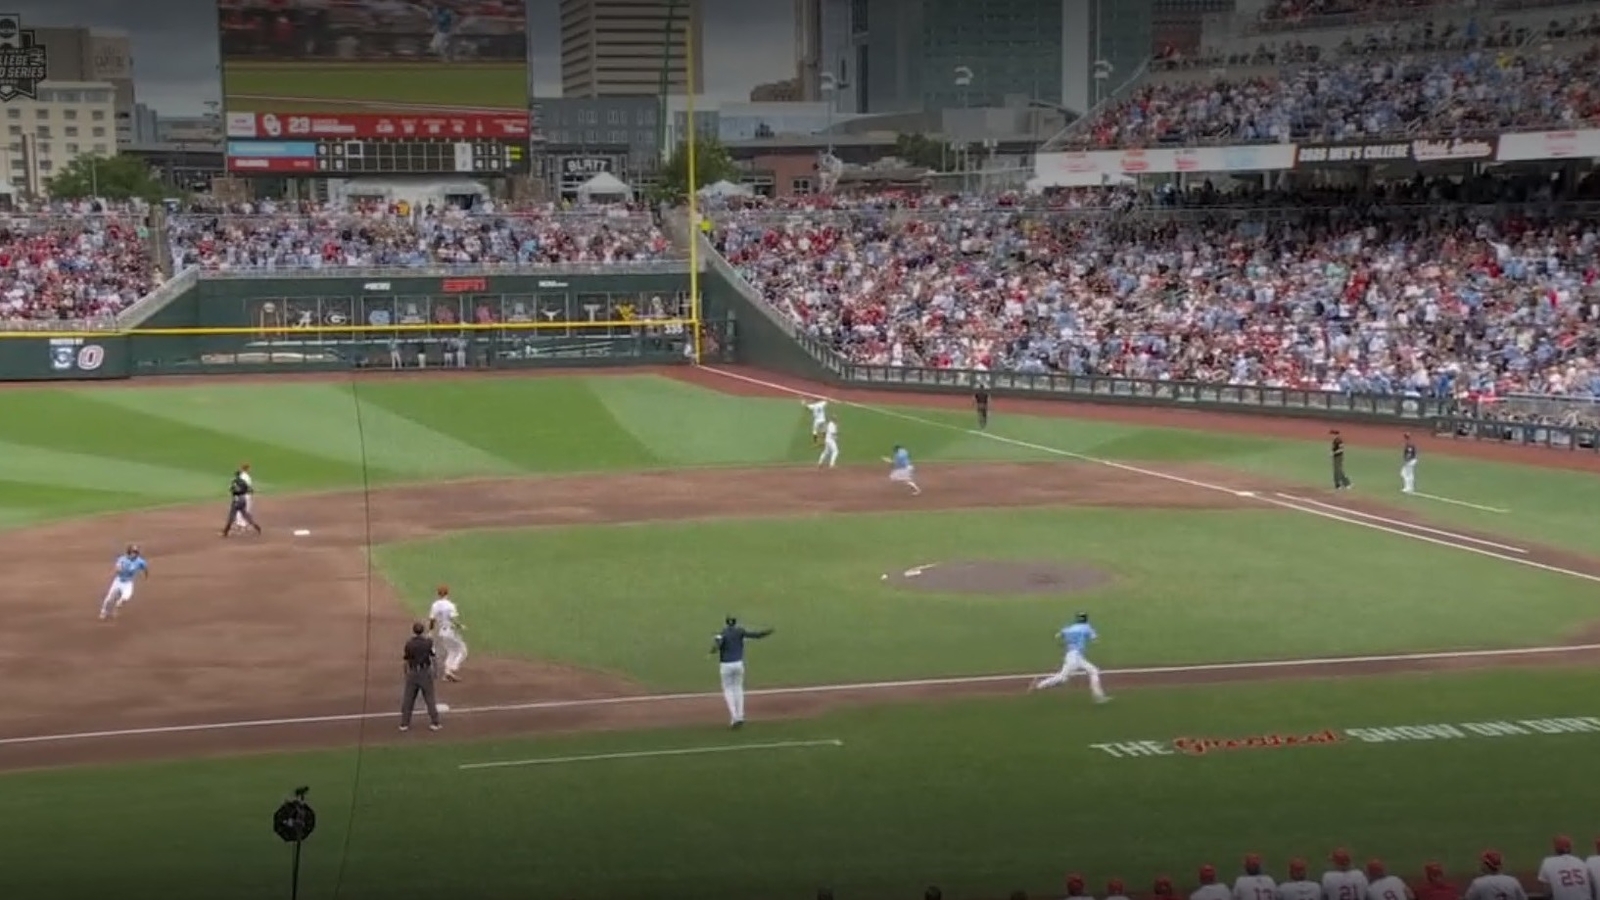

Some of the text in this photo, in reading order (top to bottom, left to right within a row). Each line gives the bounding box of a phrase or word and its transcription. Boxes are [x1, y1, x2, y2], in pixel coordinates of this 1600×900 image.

[288, 116, 311, 134] 23
[1328, 146, 1363, 161] MEN'S
[1363, 144, 1411, 159] COLLEGE
[442, 279, 487, 292] ESPN
[1089, 740, 1176, 758] THE
[1345, 723, 1466, 743] SHOW
[1460, 720, 1533, 737] ON
[1558, 869, 1585, 886] 25
[1338, 884, 1358, 900] 21
